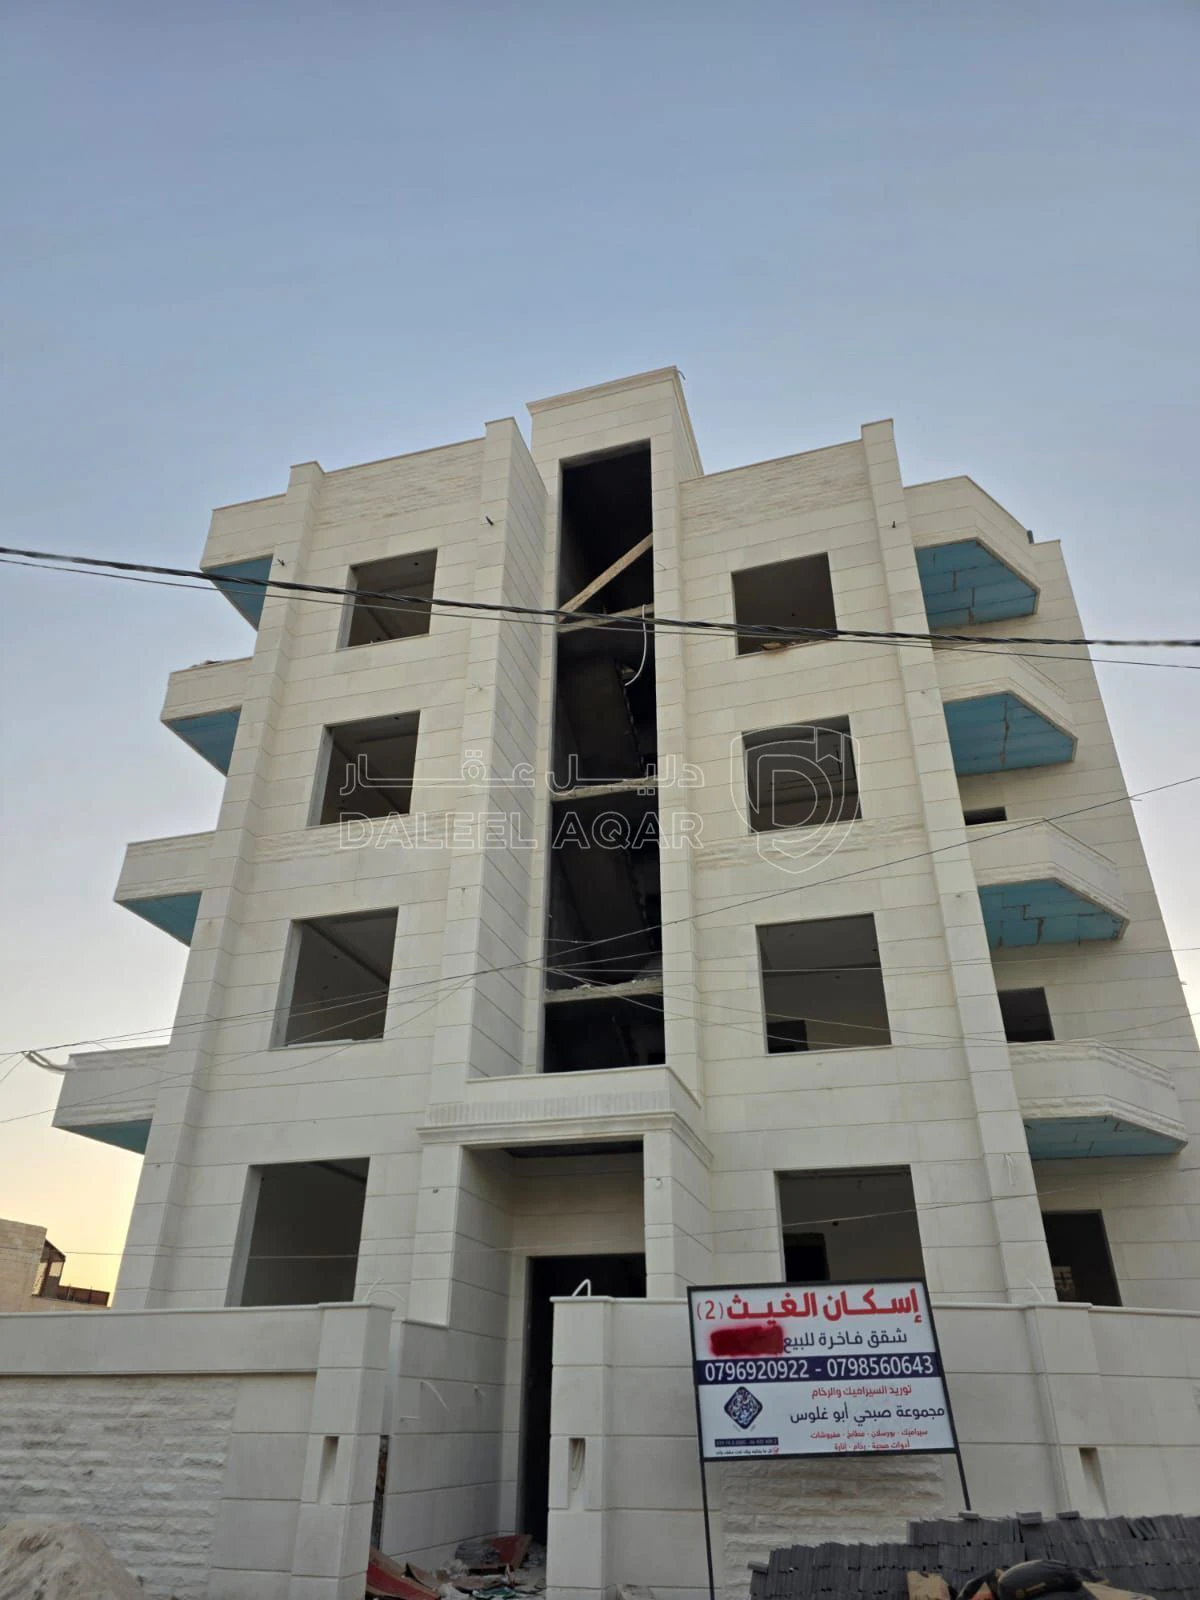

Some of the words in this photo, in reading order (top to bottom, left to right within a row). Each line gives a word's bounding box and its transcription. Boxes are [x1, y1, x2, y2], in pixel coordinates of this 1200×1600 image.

[696, 1300, 724, 1320] (2)
[726, 1292, 818, 1325] الغيث
[823, 1288, 922, 1323] إسكان
[783, 1332, 815, 1353] للبيع
[818, 1331, 863, 1350] فاخرة
[867, 1328, 907, 1349] شقق
[705, 1359, 809, 1381] 0796920922
[827, 1355, 934, 1377] 0798560643
[811, 1387, 842, 1399] والرخام
[843, 1385, 888, 1397] السيراميك
[889, 1384, 912, 1396] توريد
[790, 1406, 829, 1424] غلوس
[833, 1401, 849, 1422] أبو
[853, 1408, 892, 1427] صبحي
[896, 1405, 945, 1420] مجموعة
